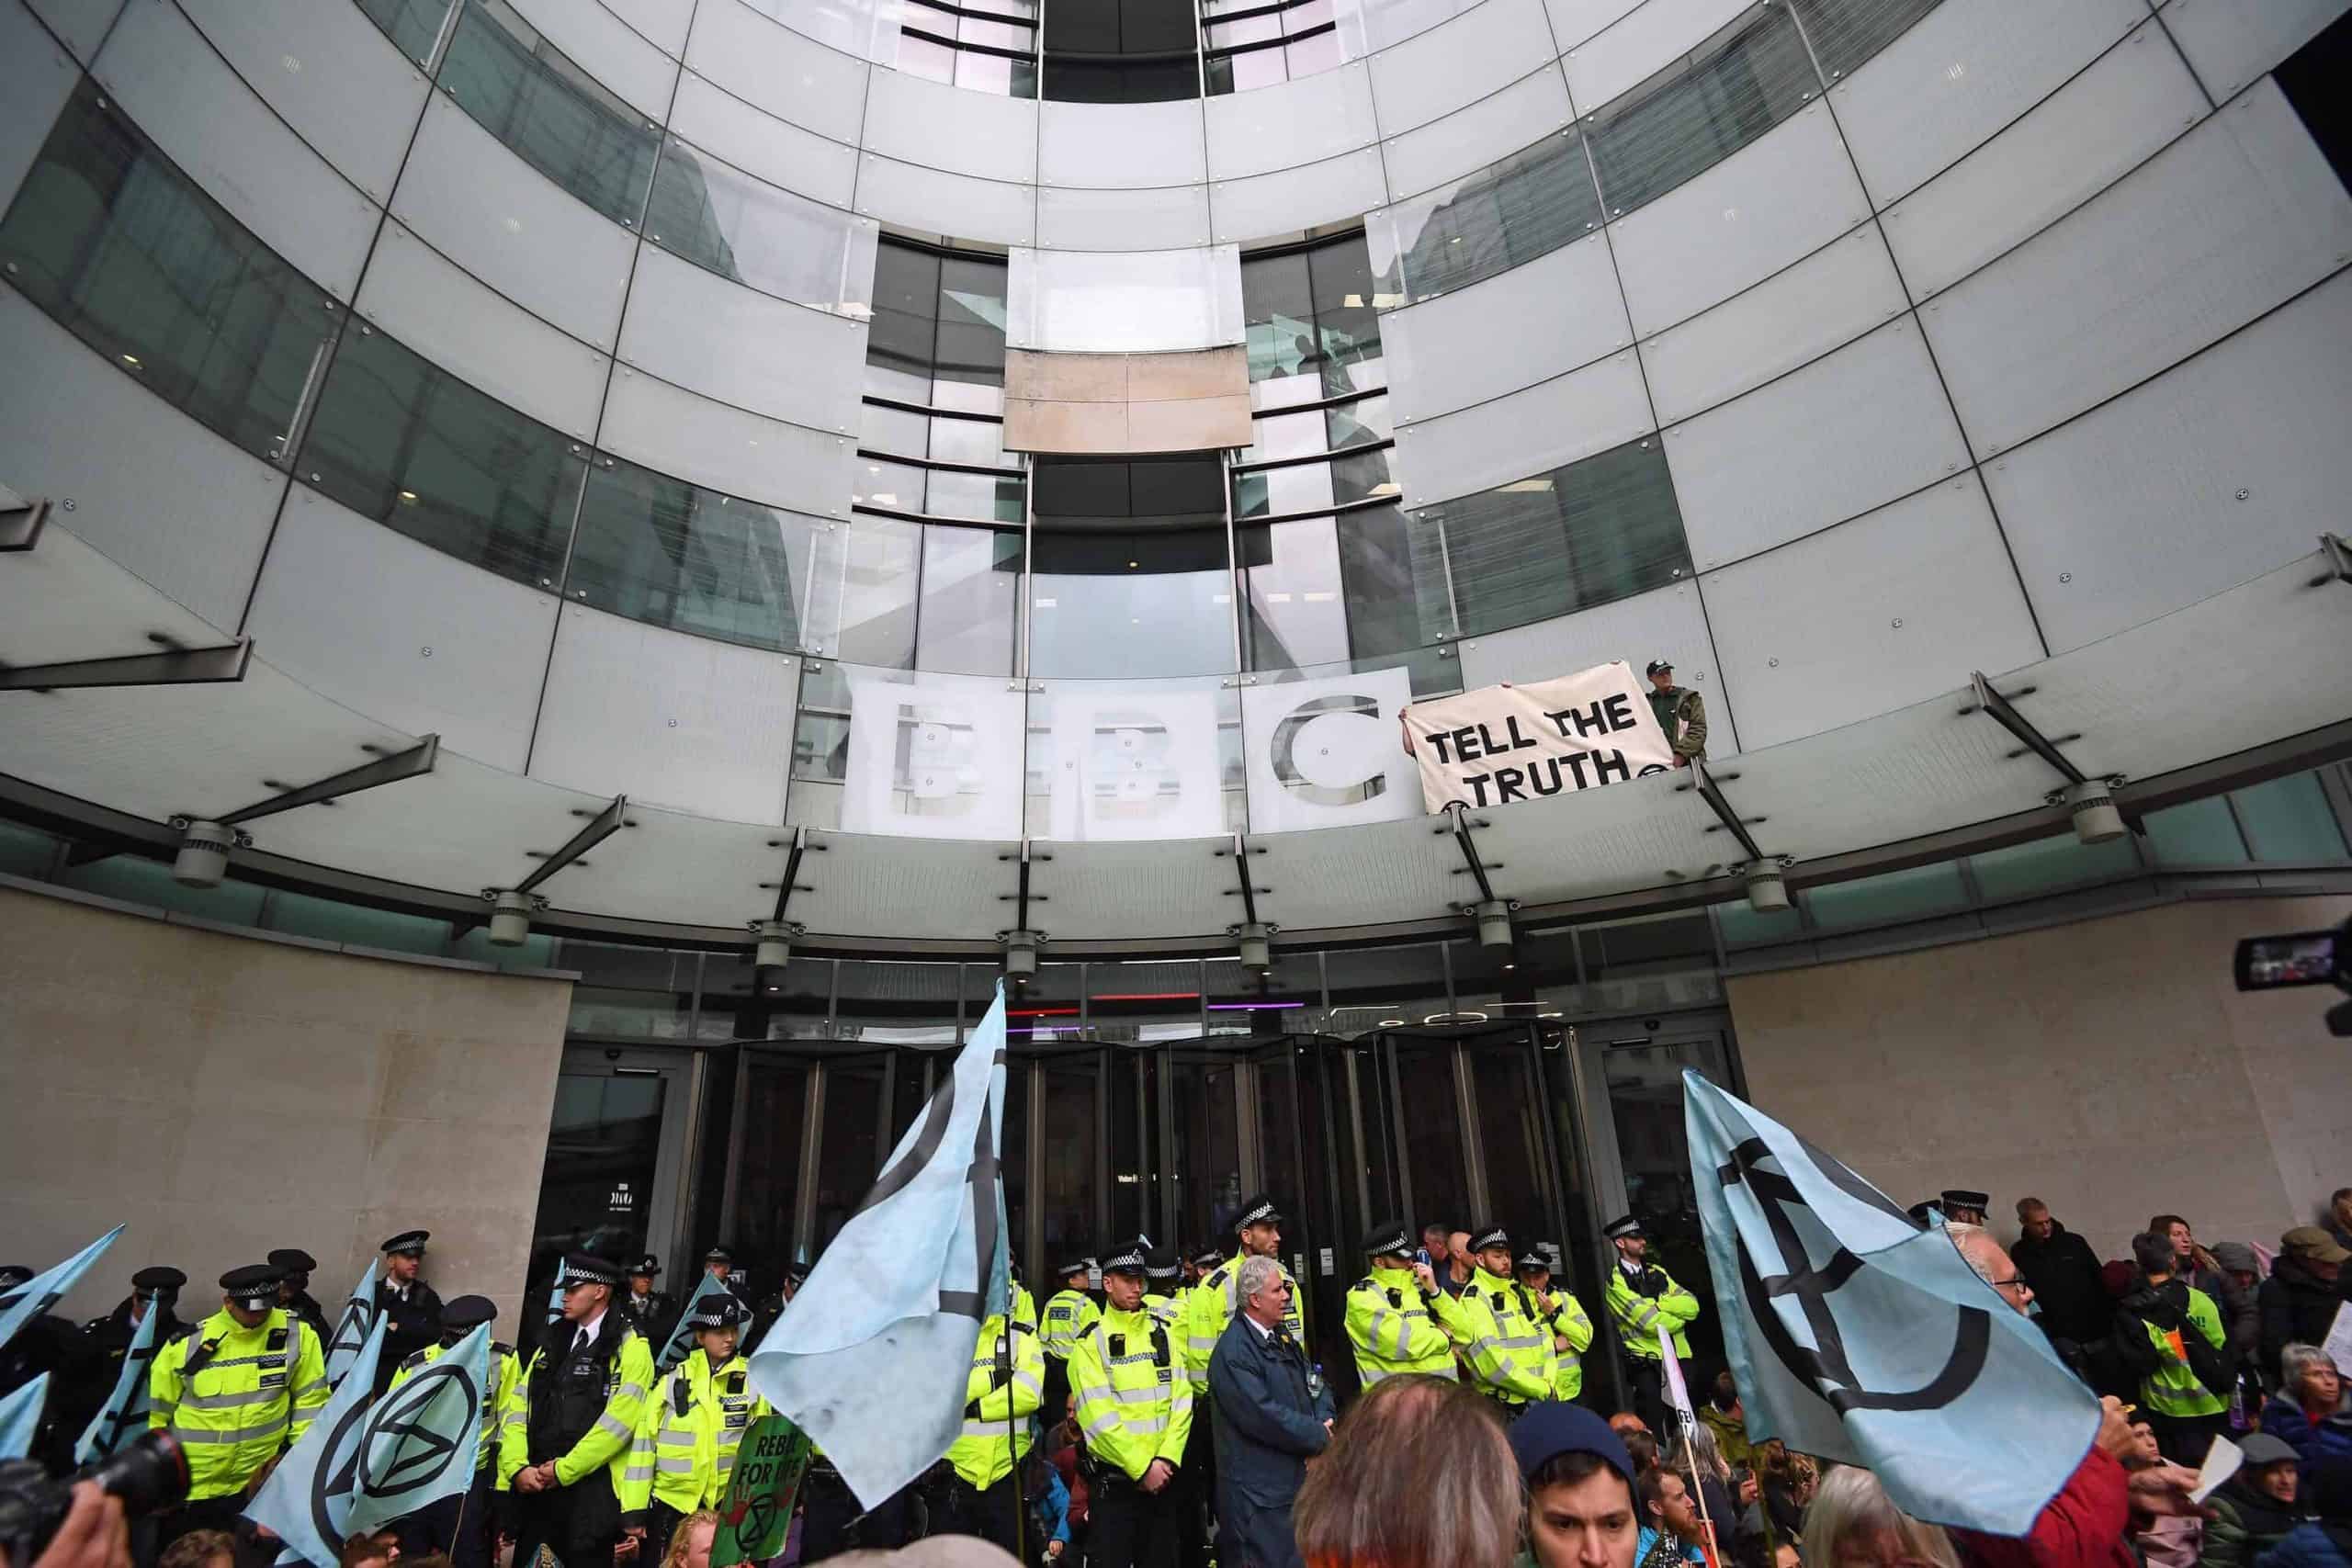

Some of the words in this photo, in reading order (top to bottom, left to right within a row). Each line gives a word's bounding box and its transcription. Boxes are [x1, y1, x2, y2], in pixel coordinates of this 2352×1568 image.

[890, 694, 1388, 820] BBC
[1426, 716, 1537, 764] TELL
[1544, 694, 1637, 738] THE
[1463, 749, 1631, 807] TRUTH
[736, 1462, 773, 1485] FOR
